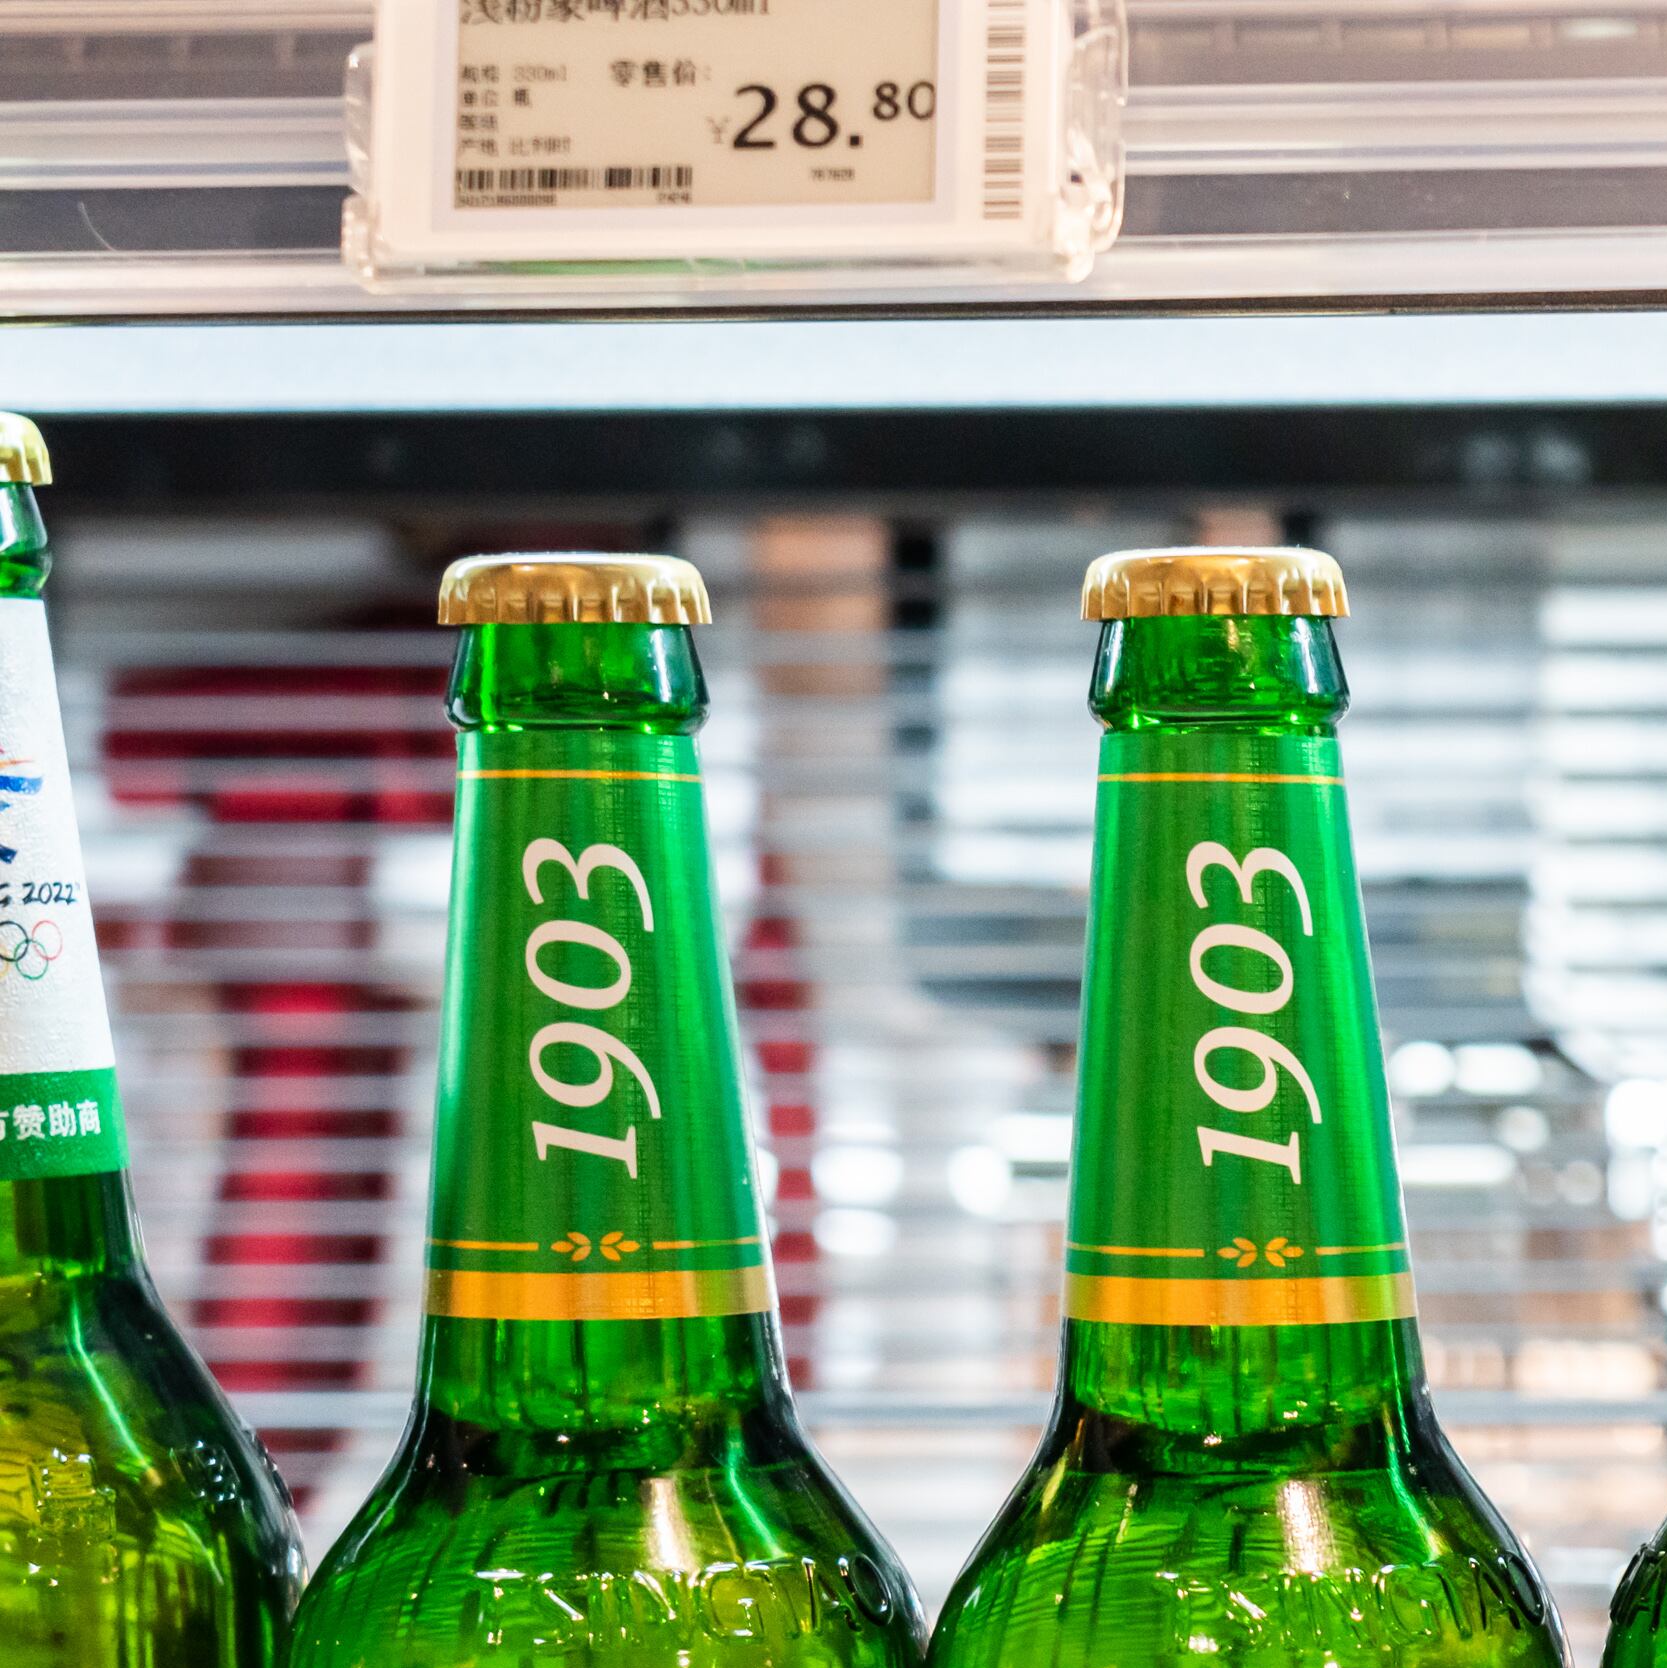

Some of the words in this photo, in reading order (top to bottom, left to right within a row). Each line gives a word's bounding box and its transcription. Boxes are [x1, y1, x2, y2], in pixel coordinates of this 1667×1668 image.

[22, 881, 77, 907] 2022
[523, 839, 660, 1178] 1903
[1186, 842, 1321, 1184] 1903
